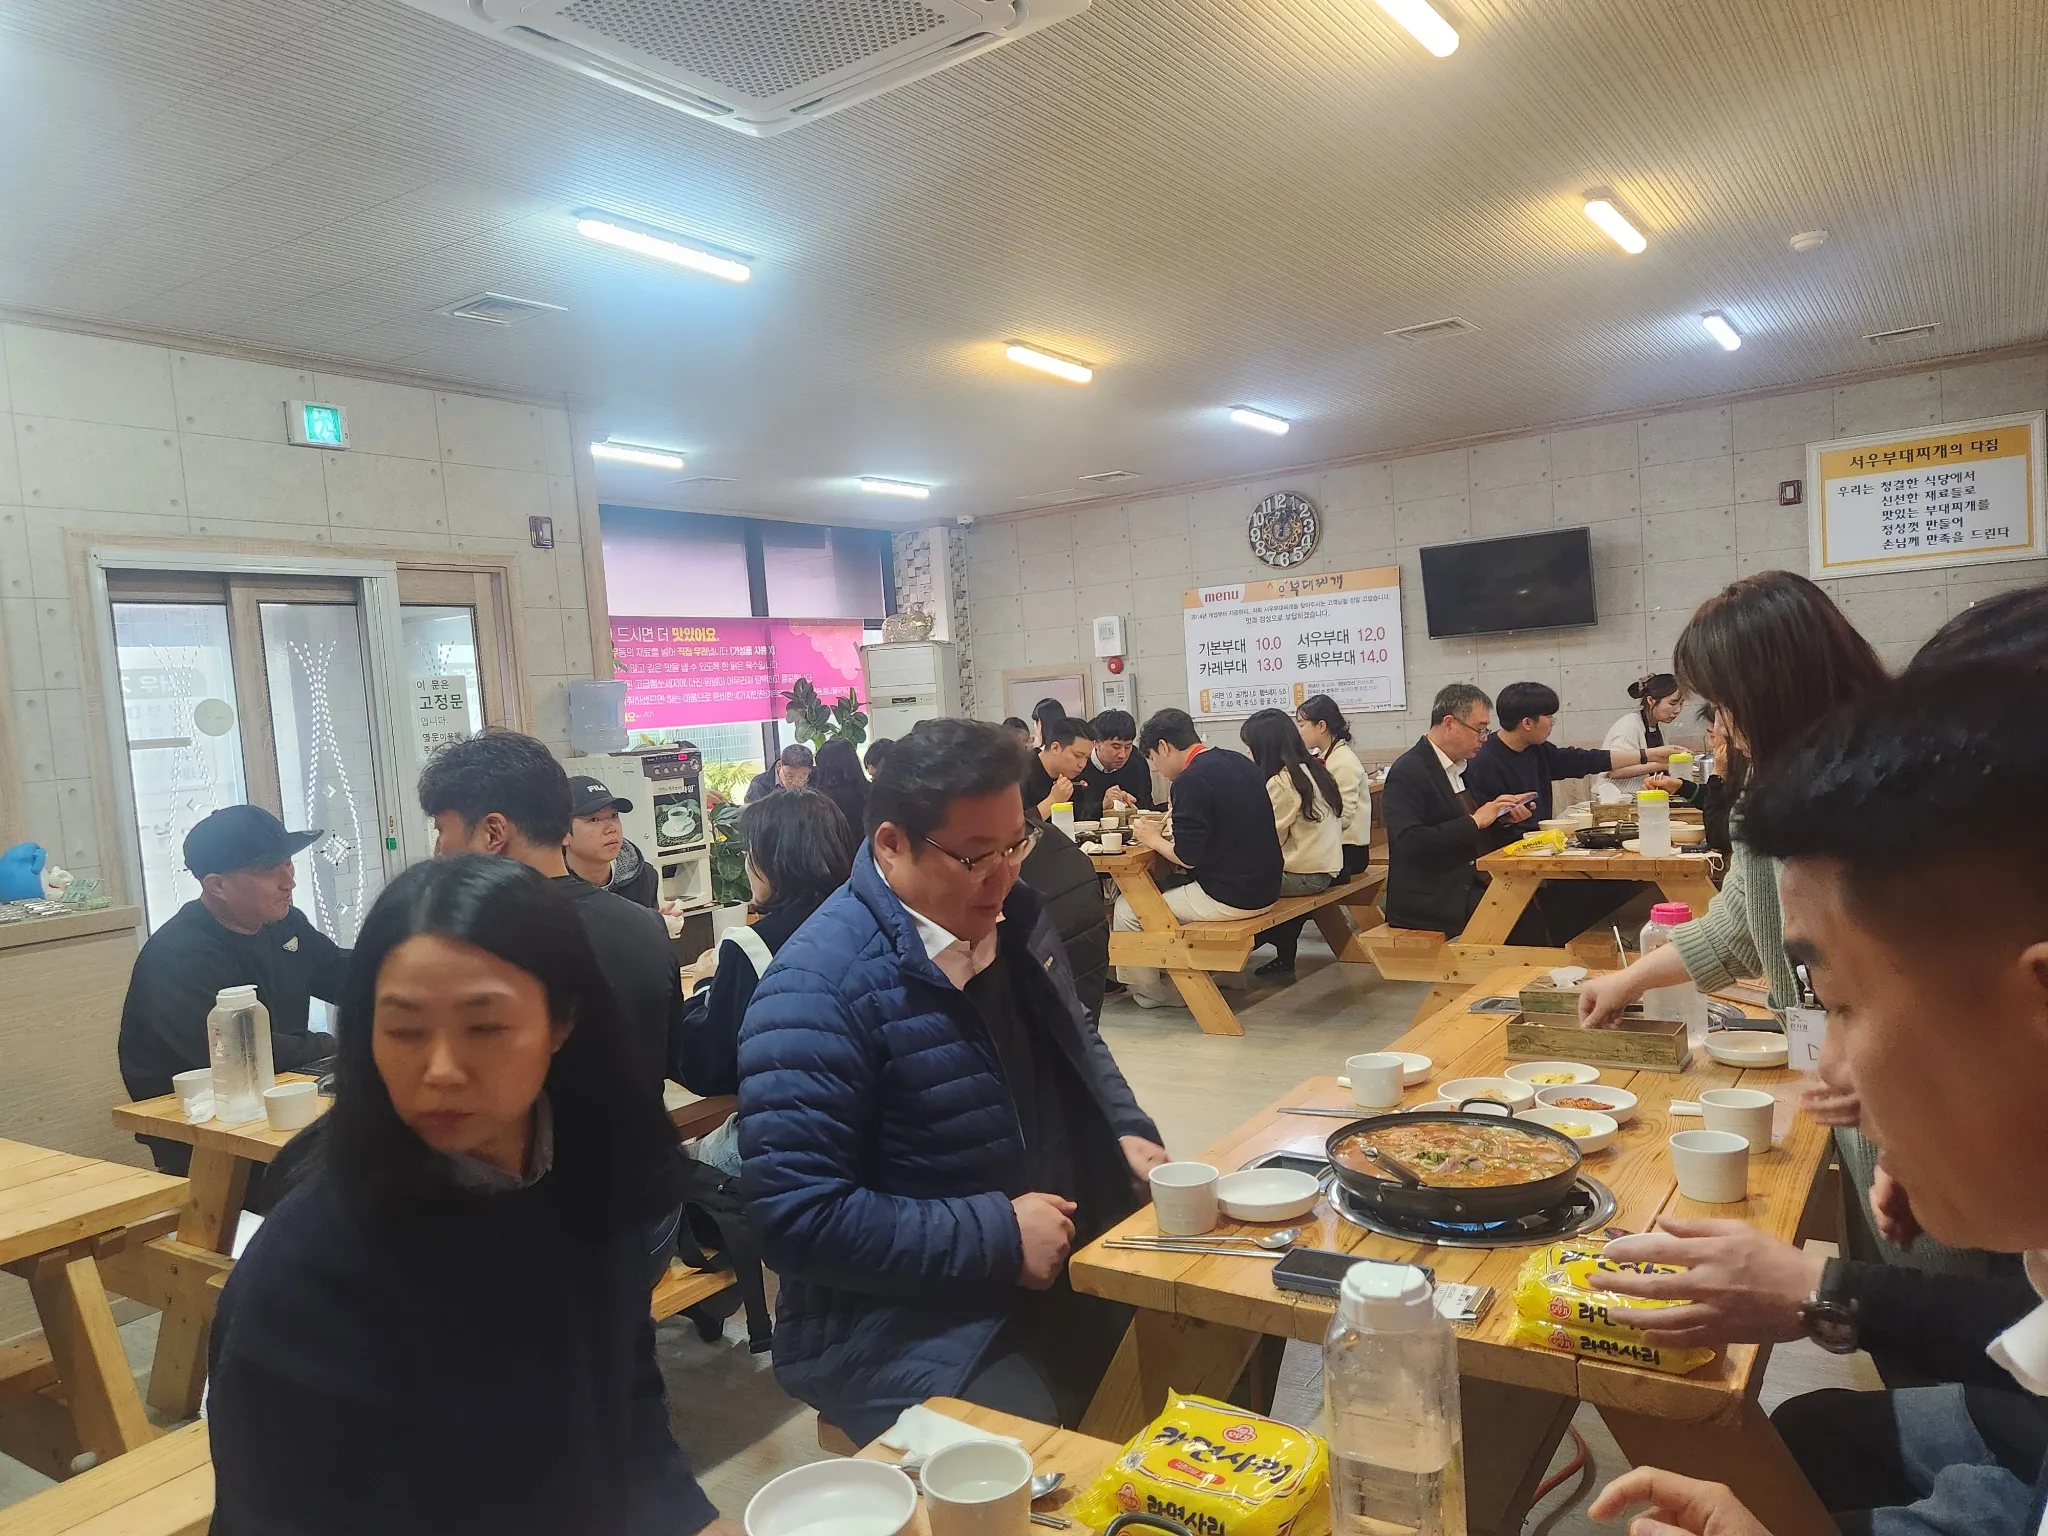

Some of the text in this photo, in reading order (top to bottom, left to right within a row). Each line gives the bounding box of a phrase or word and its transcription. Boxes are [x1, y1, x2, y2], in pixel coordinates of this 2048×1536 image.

[1849, 438, 1999, 469] 서우부대찌개의 다짐
[1837, 470, 1976, 498] 우리는 청결한 식당에서
[1273, 494, 1287, 509] 12
[1289, 496, 1297, 510] 1
[1882, 485, 1977, 507] 신선한 재료들로
[1261, 499, 1271, 514] 11
[1299, 502, 1311, 518] 2
[1882, 499, 1991, 522] 맛있는 부대찌개를
[1252, 512, 1264, 526] 10
[1303, 518, 1315, 533] 3
[1882, 516, 1964, 536] 정성껏 만들어
[1250, 527, 1261, 542] 9
[1301, 534, 1313, 549] 4
[1882, 526, 2011, 550] 손님께 만족을 드린다
[1255, 540, 1266, 556] 8
[1293, 546, 1304, 561] 5
[1266, 551, 1277, 564] 7
[1280, 551, 1290, 567] 6
[1204, 590, 1239, 602] menu
[1245, 609, 1331, 625] 맛과 정성으로 보답하겠습니다.
[617, 626, 655, 643] 드시면
[657, 626, 669, 642] 더
[671, 626, 721, 643] 맛있어요.
[1199, 626, 1386, 657] 기본부대 10.0 서우부대 12.0
[636, 646, 660, 658] 재료를
[677, 646, 693, 658] 직접
[647, 663, 663, 674] 깊은
[699, 661, 720, 672] 있도록
[745, 660, 779, 671] 육수입니다
[1199, 648, 1388, 677] 카레부대 13.0 통새우부대 14.0
[416, 679, 450, 691] 이 문은
[420, 694, 464, 711] 고정문
[420, 716, 449, 727] 입니다.
[1580, 1335, 1661, 1366] 라면사리
[1151, 1426, 1294, 1484] 라면사리
